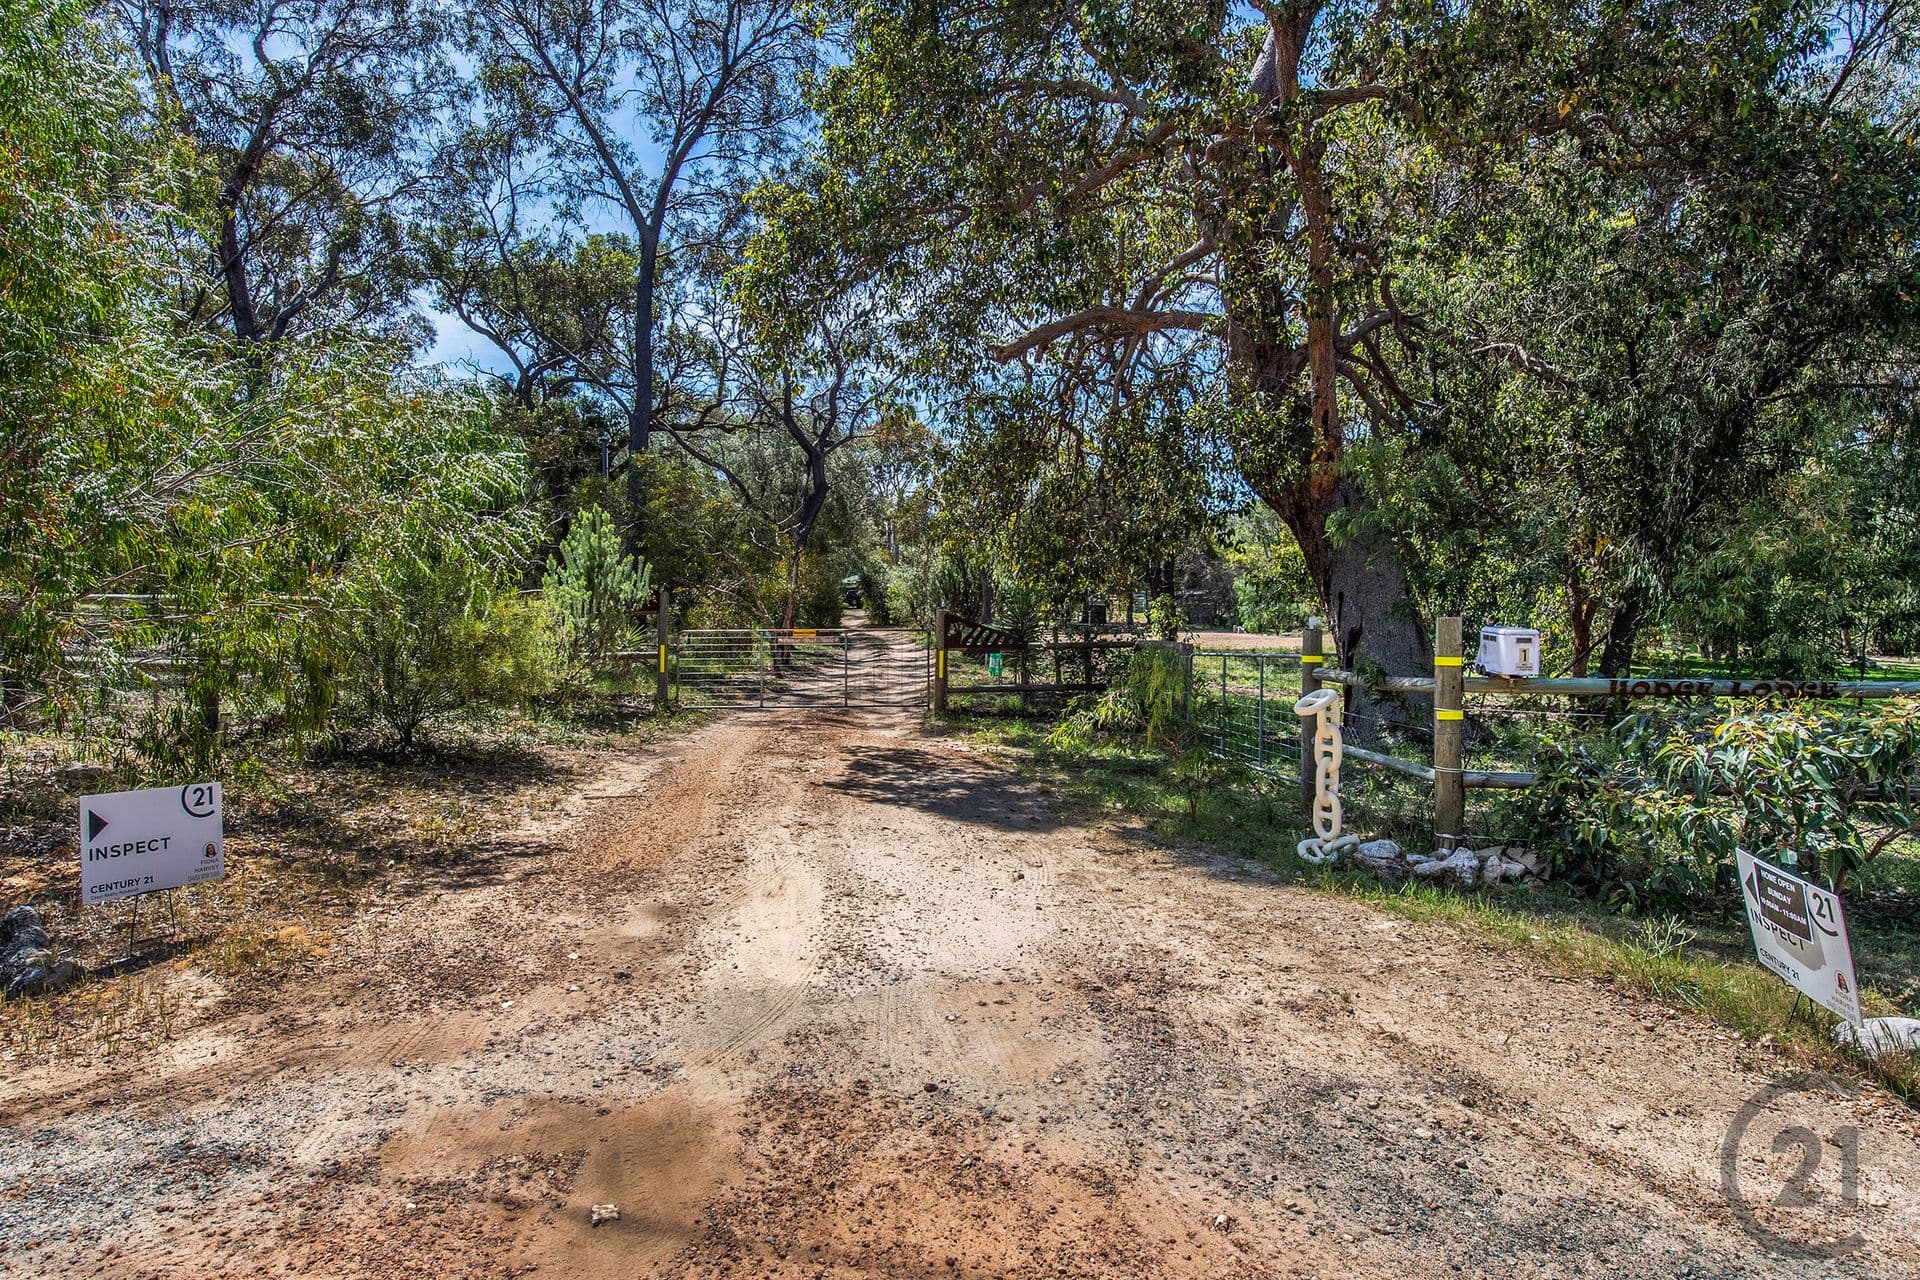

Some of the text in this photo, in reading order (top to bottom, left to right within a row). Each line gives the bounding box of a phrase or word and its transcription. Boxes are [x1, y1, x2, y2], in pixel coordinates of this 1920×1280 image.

[89, 837, 171, 862] INSPECT
[90, 875, 154, 894] CENTURY 21
[1761, 869, 1796, 894] HOME OPEN
[1767, 886, 1793, 905] SUNDAY
[1759, 947, 1791, 977] CENTURY
[1791, 968, 1801, 982] 21
